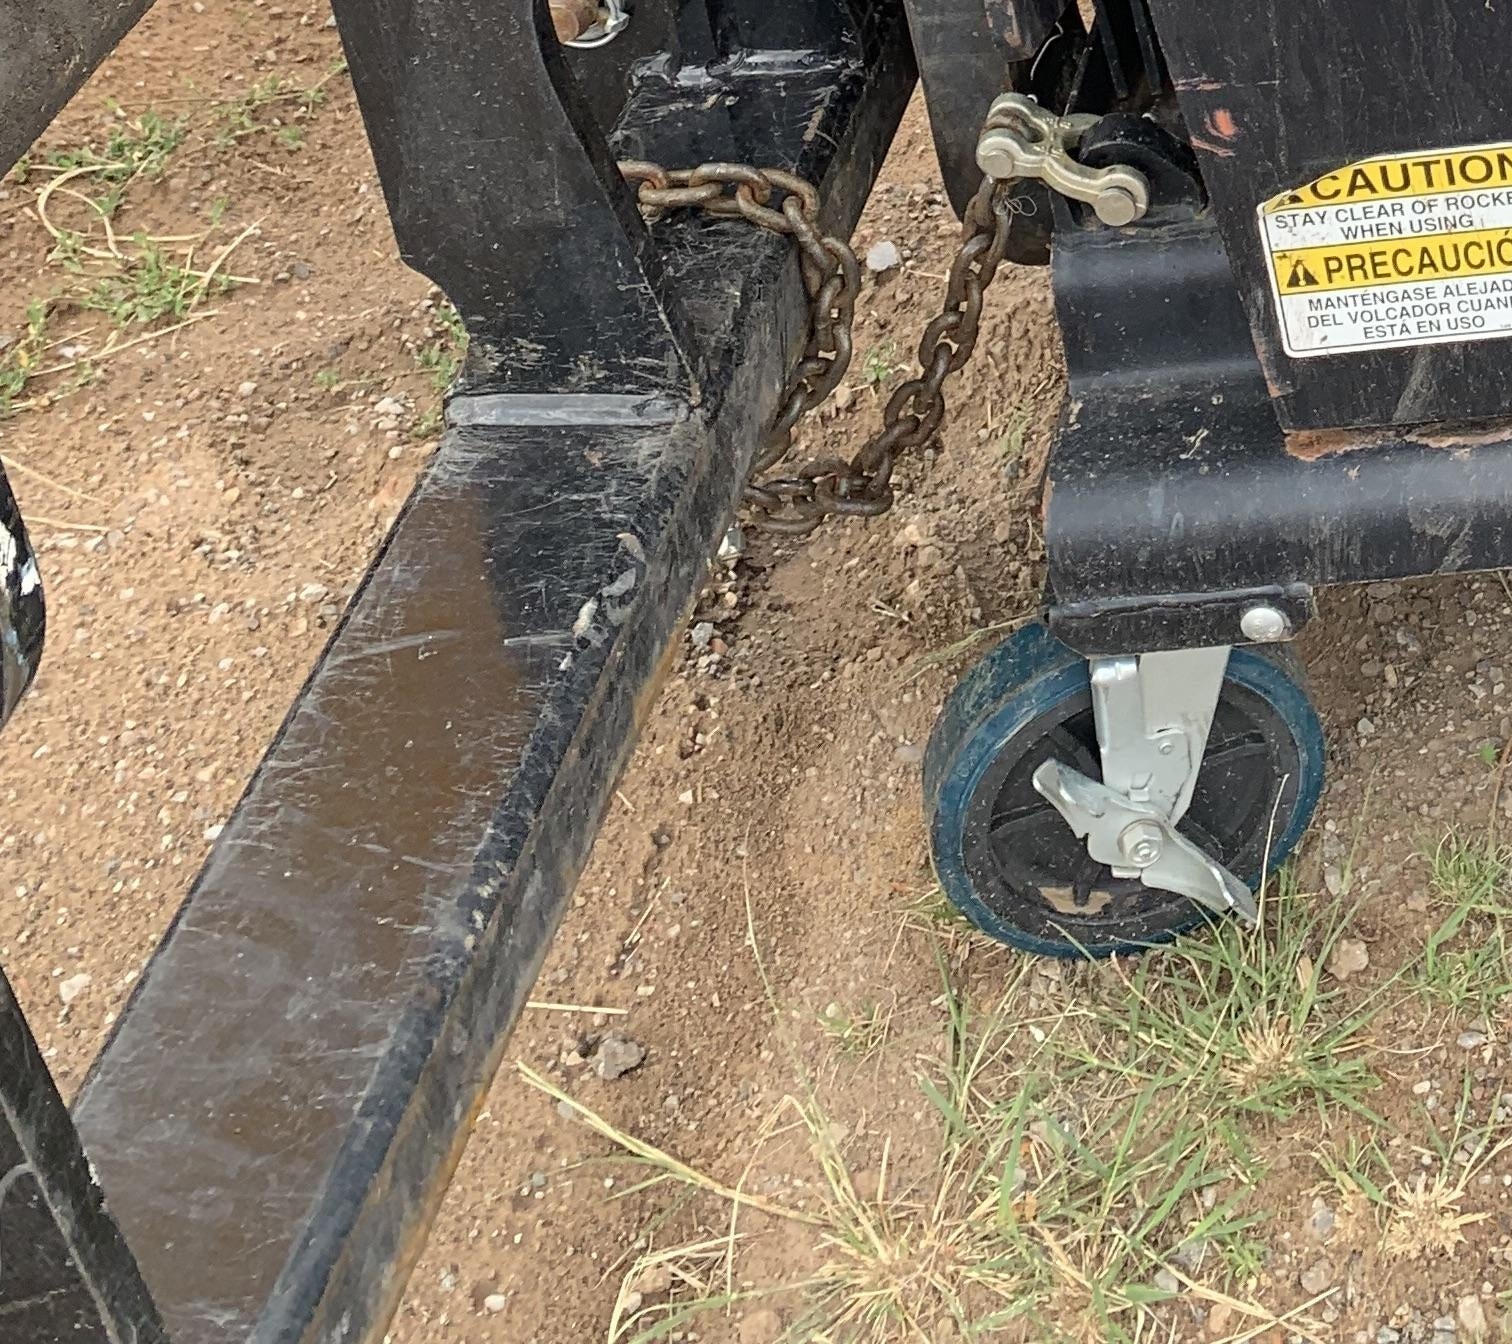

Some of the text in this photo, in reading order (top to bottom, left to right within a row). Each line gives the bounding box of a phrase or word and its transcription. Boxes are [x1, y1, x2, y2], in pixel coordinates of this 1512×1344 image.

[1275, 211, 1327, 229] STAY
[1335, 203, 1405, 223] CLEAR
[1412, 197, 1439, 215] OF
[1341, 214, 1474, 241] WHEN USING
[1308, 285, 1437, 311] MANTÉNGASE
[1307, 314, 1343, 329] DEL
[1349, 303, 1451, 324] VOLCADOR
[1364, 319, 1412, 339] ESTÁ
[1417, 320, 1441, 334] EN
[1448, 315, 1485, 330] USO
